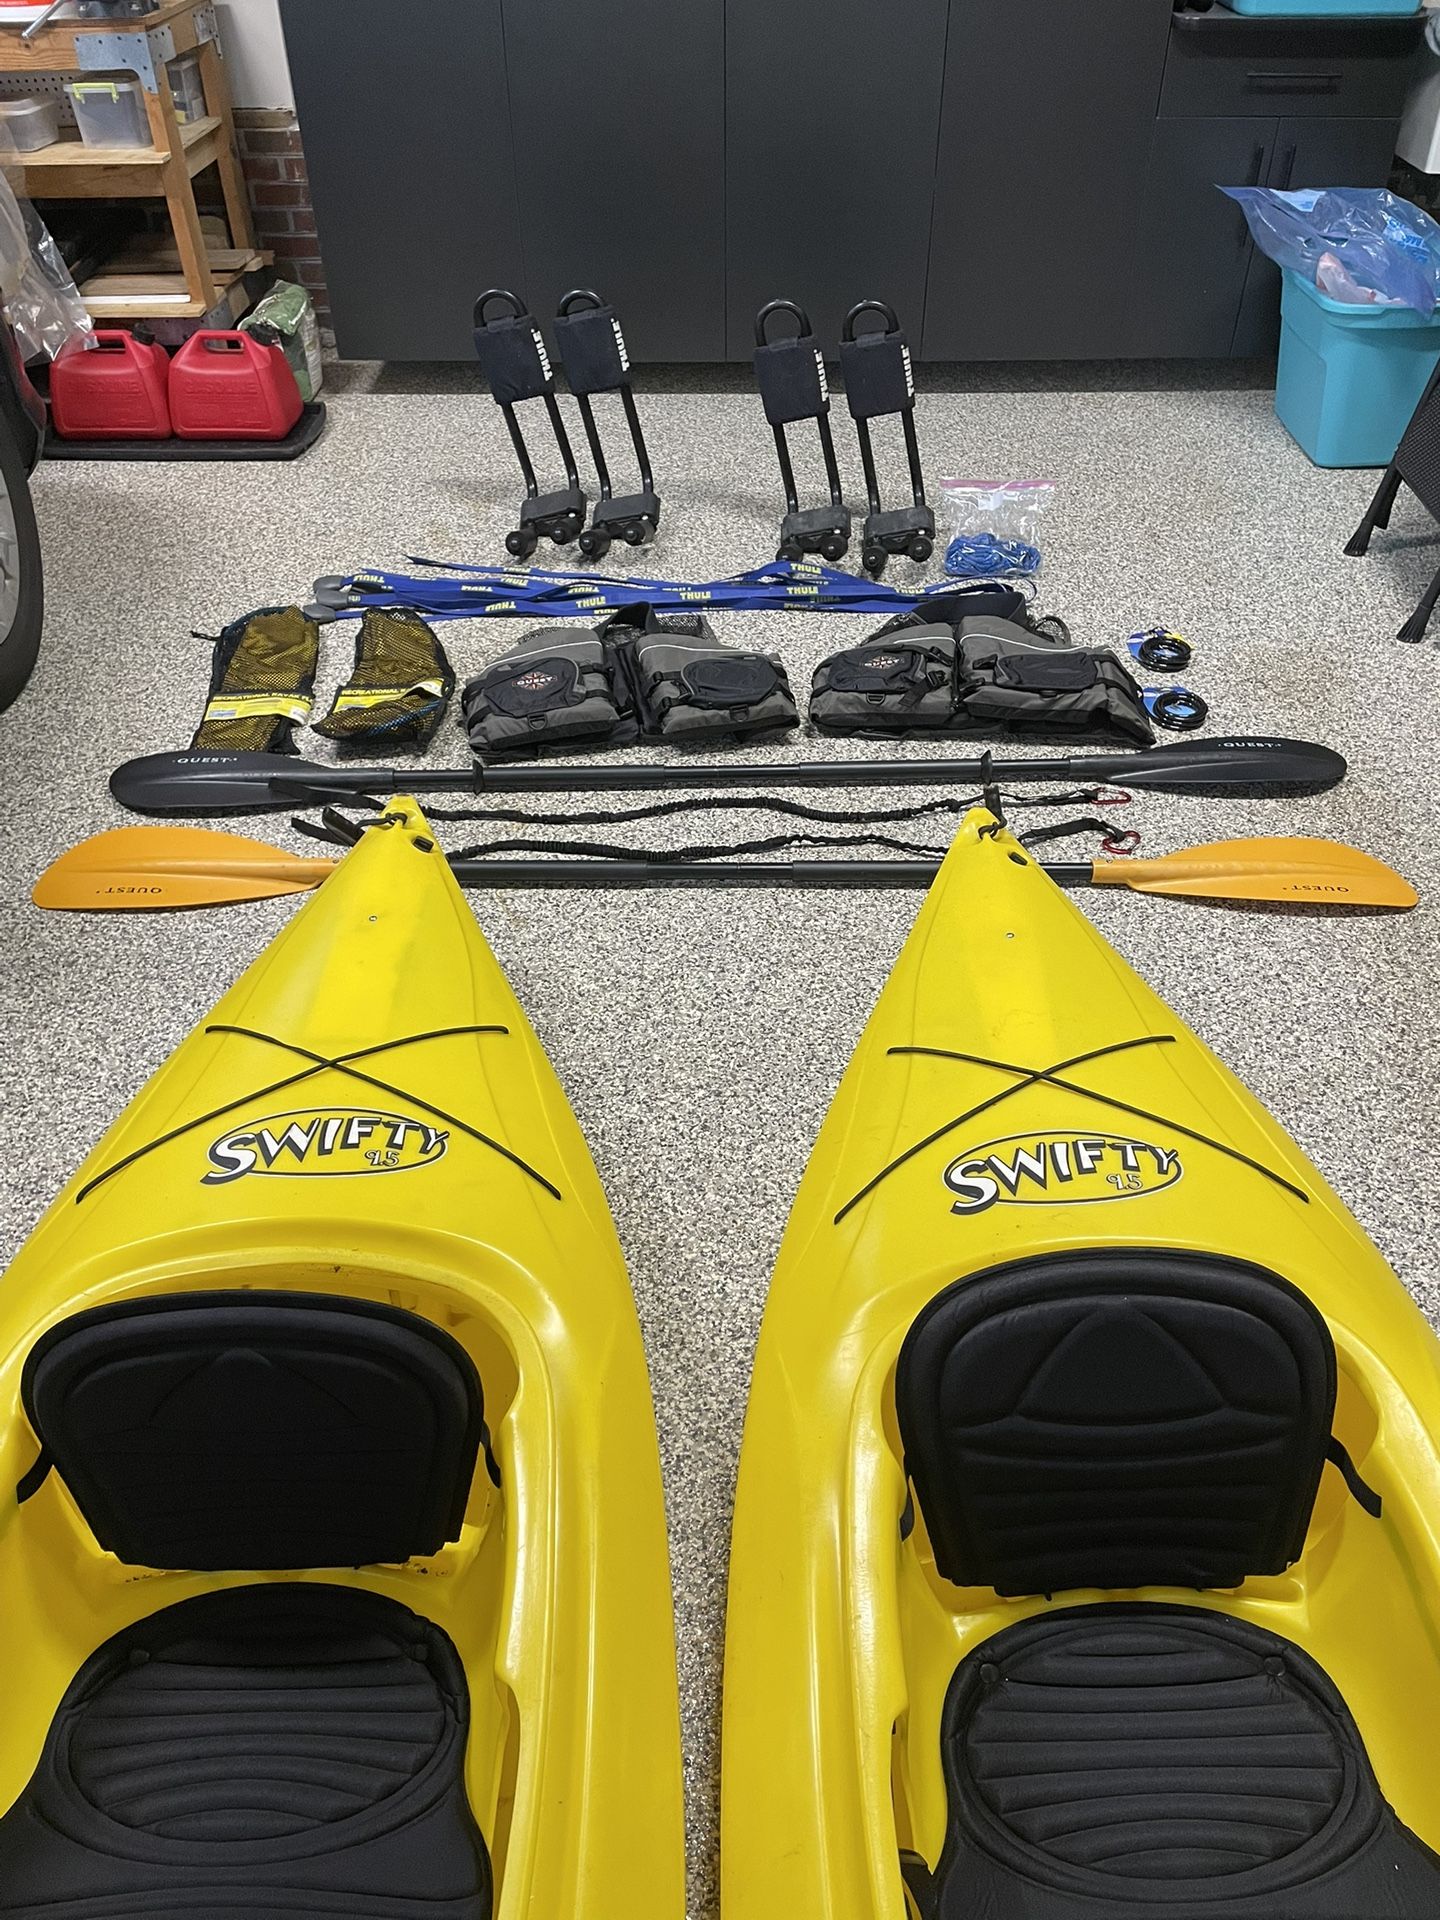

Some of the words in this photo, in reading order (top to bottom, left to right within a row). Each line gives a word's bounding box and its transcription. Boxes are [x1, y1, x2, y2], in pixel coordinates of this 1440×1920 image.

[612, 318, 630, 372] THULE
[532, 329, 553, 381] THULE
[814, 349, 829, 402] THULE
[901, 345, 915, 398] THULE
[790, 563, 822, 574] THULE
[353, 575, 385, 583] THULE
[680, 591, 711, 600] THULE
[786, 586, 819, 594] THULE
[485, 601, 516, 612] THULE
[576, 596, 606, 608] THULE
[213, 693, 269, 701] RECREATIONAL
[1290, 885, 1349, 893] QUEST
[199, 1116, 449, 1186] SWIFTY
[949, 1138, 1179, 1216] SWIFTY
